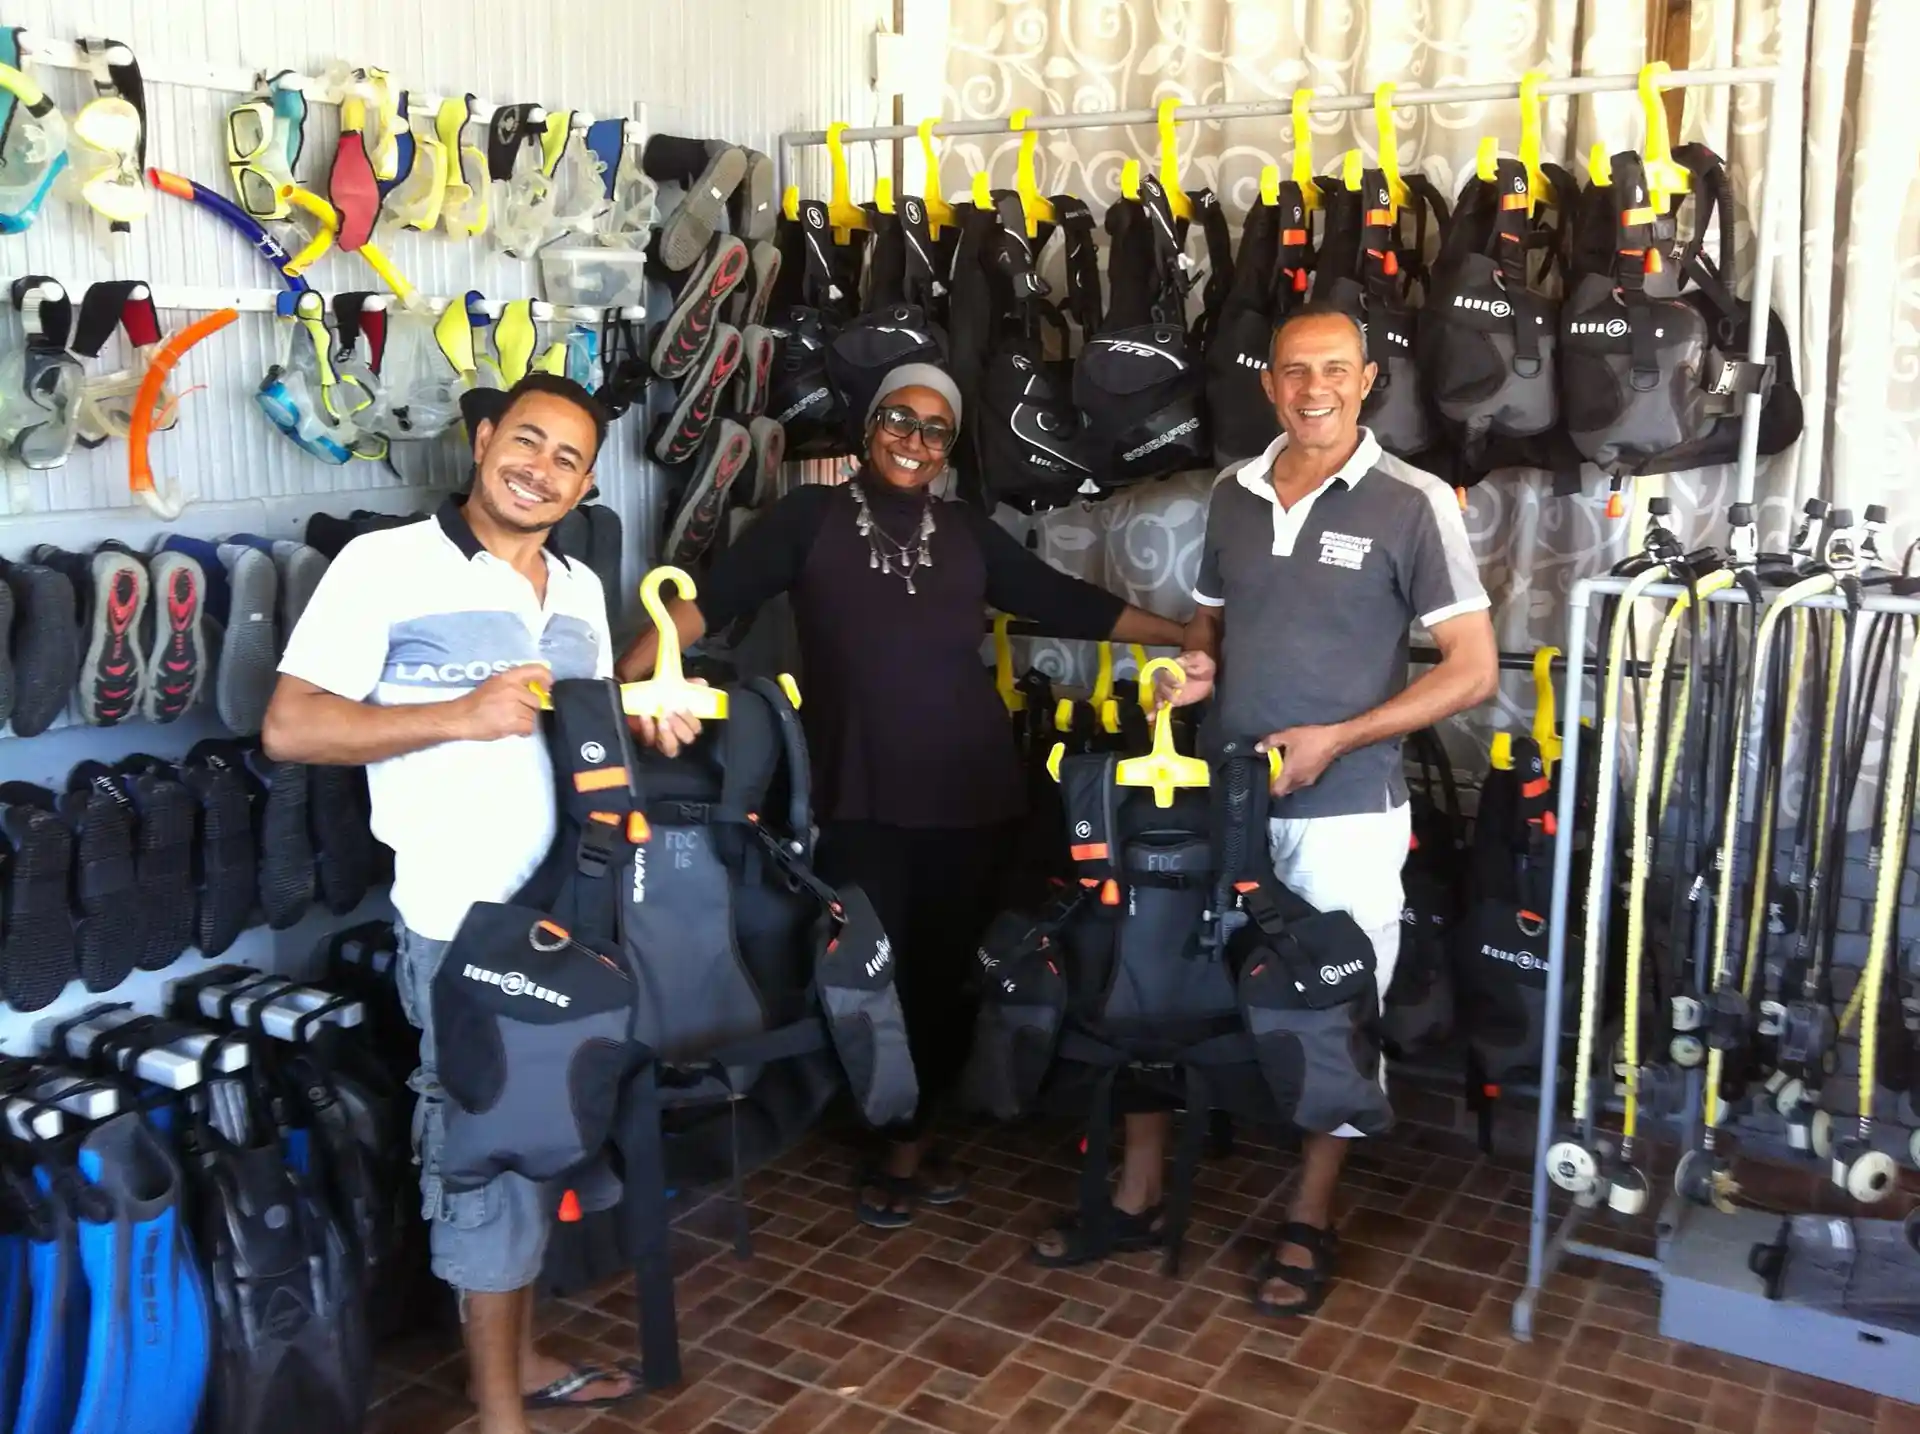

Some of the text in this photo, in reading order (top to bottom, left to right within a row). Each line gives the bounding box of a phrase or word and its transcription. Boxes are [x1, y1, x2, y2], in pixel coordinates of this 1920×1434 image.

[1454, 295, 1490, 312] AQUA
[1571, 322, 1605, 334] AQUA
[1387, 331, 1409, 348] UNG
[1122, 417, 1200, 461] SCUBAPRO
[396, 659, 520, 683] LACOS
[1148, 854, 1183, 872] FDC
[1481, 944, 1515, 963] AQUA
[1336, 959, 1365, 977] LUNG
